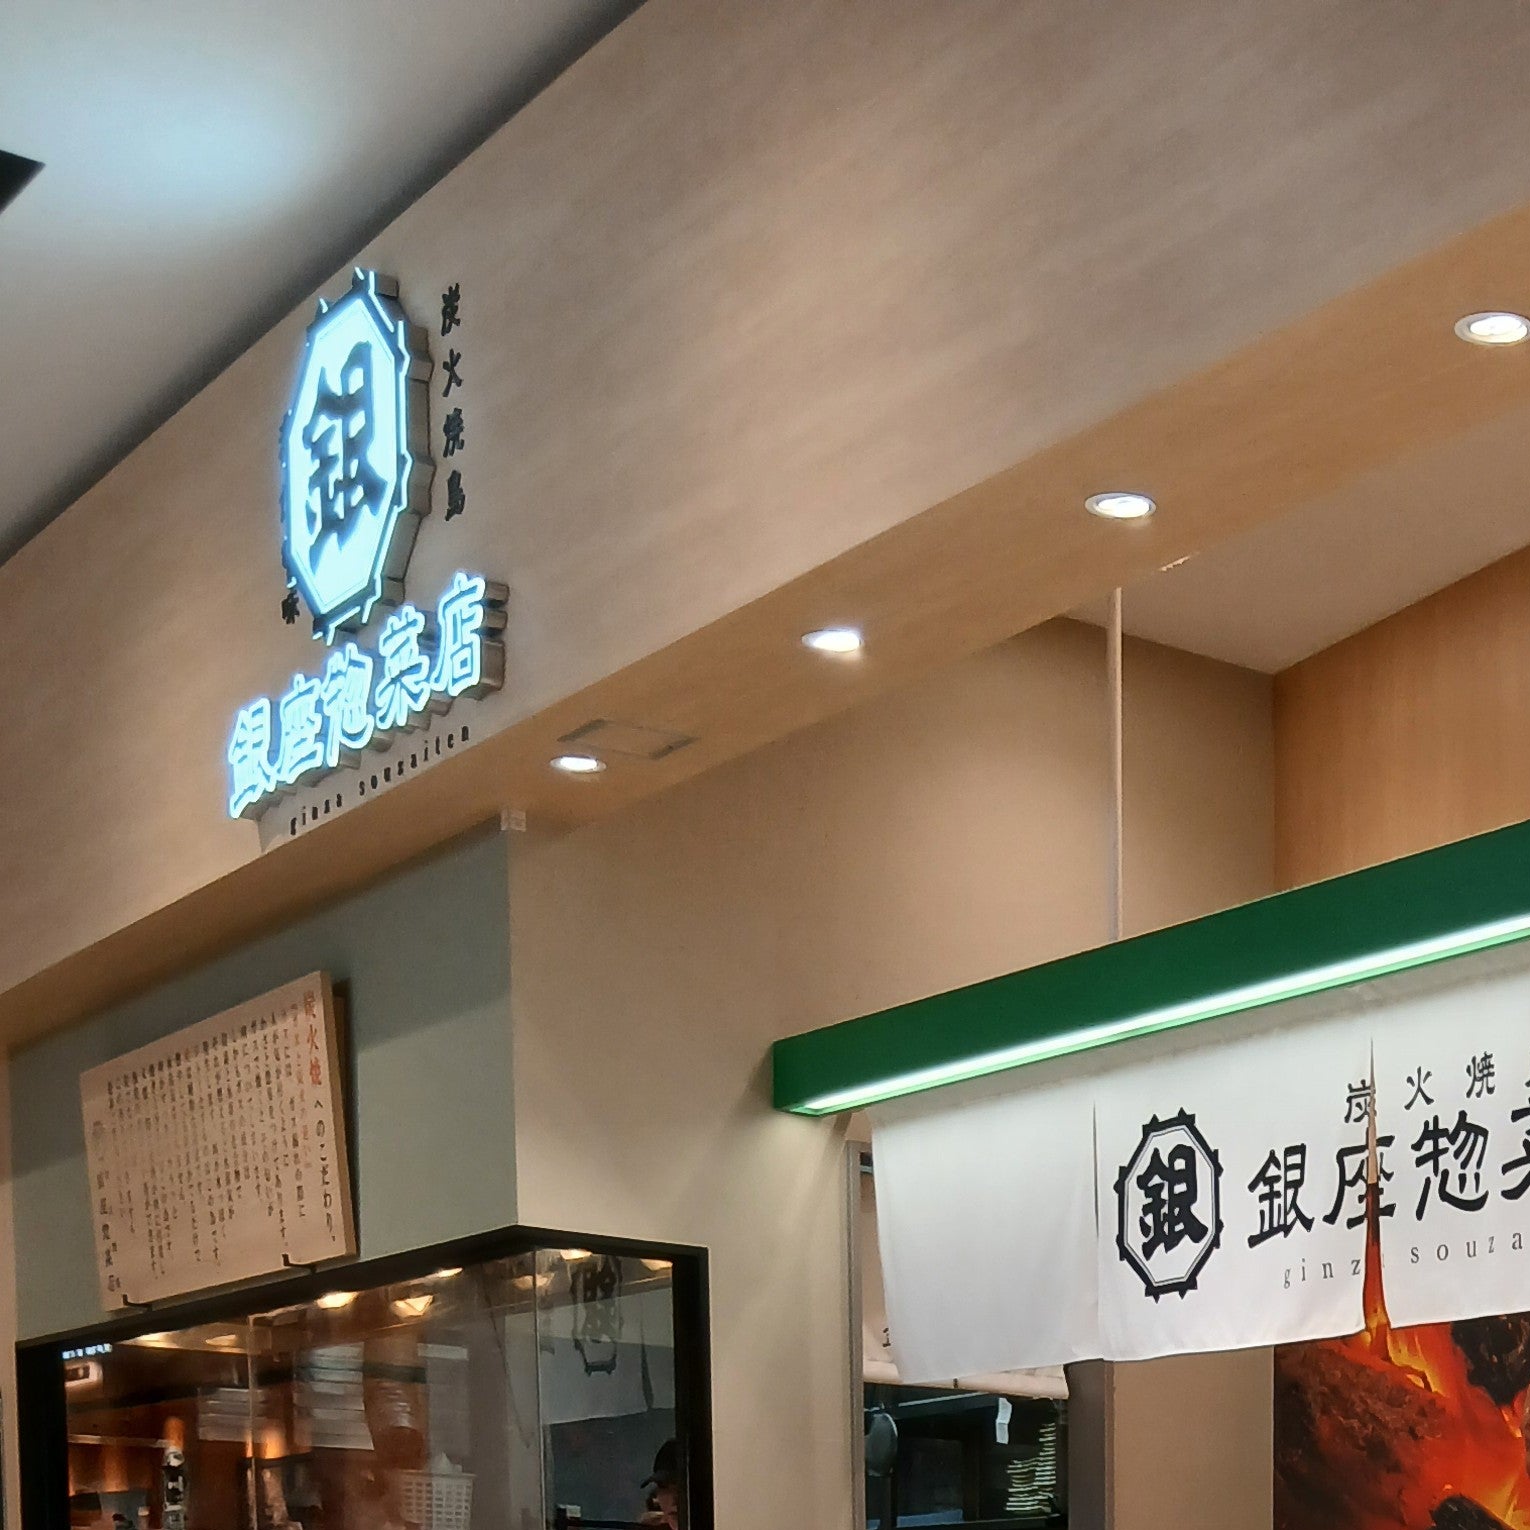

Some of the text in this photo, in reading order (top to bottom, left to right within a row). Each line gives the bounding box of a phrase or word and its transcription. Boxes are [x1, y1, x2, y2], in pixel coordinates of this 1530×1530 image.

[303, 338, 388, 572] 銀
[440, 282, 467, 522] 炭火焼鳥
[227, 572, 487, 820] 銀座惣菜店
[1134, 1143, 1210, 1262] 銀
[1282, 1253, 1387, 1289] ginz
